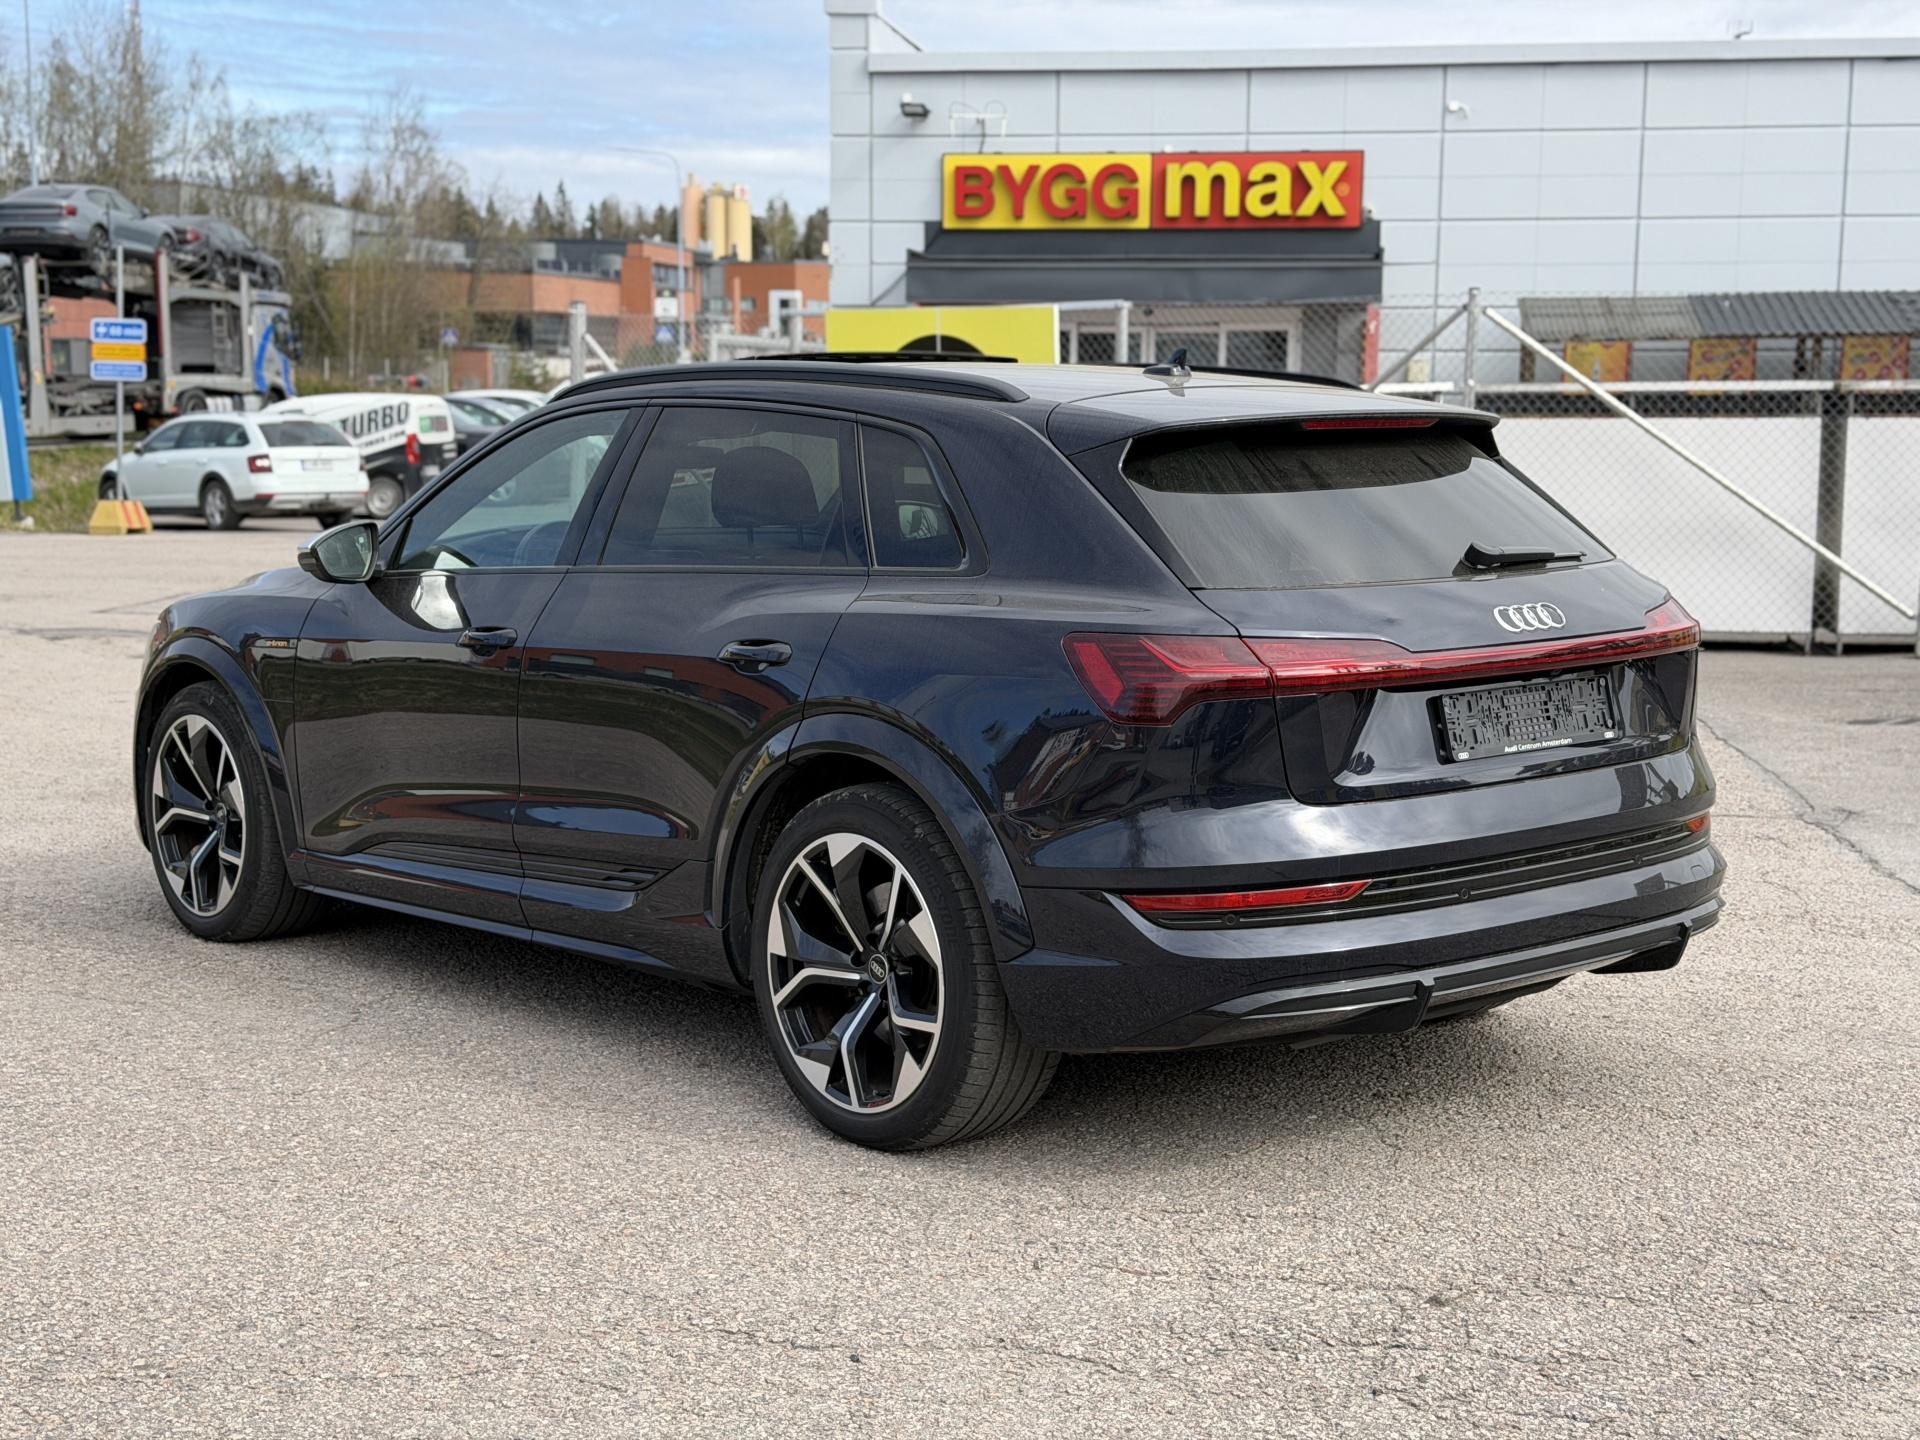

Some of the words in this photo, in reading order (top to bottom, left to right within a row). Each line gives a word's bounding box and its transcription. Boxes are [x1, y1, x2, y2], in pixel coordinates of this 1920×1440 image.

[953, 162, 1139, 219] BYGG
[1165, 160, 1347, 218] max
[339, 401, 410, 439] TURBO
[1504, 745, 1518, 753] Audi
[1542, 737, 1573, 747] Amsterdam
